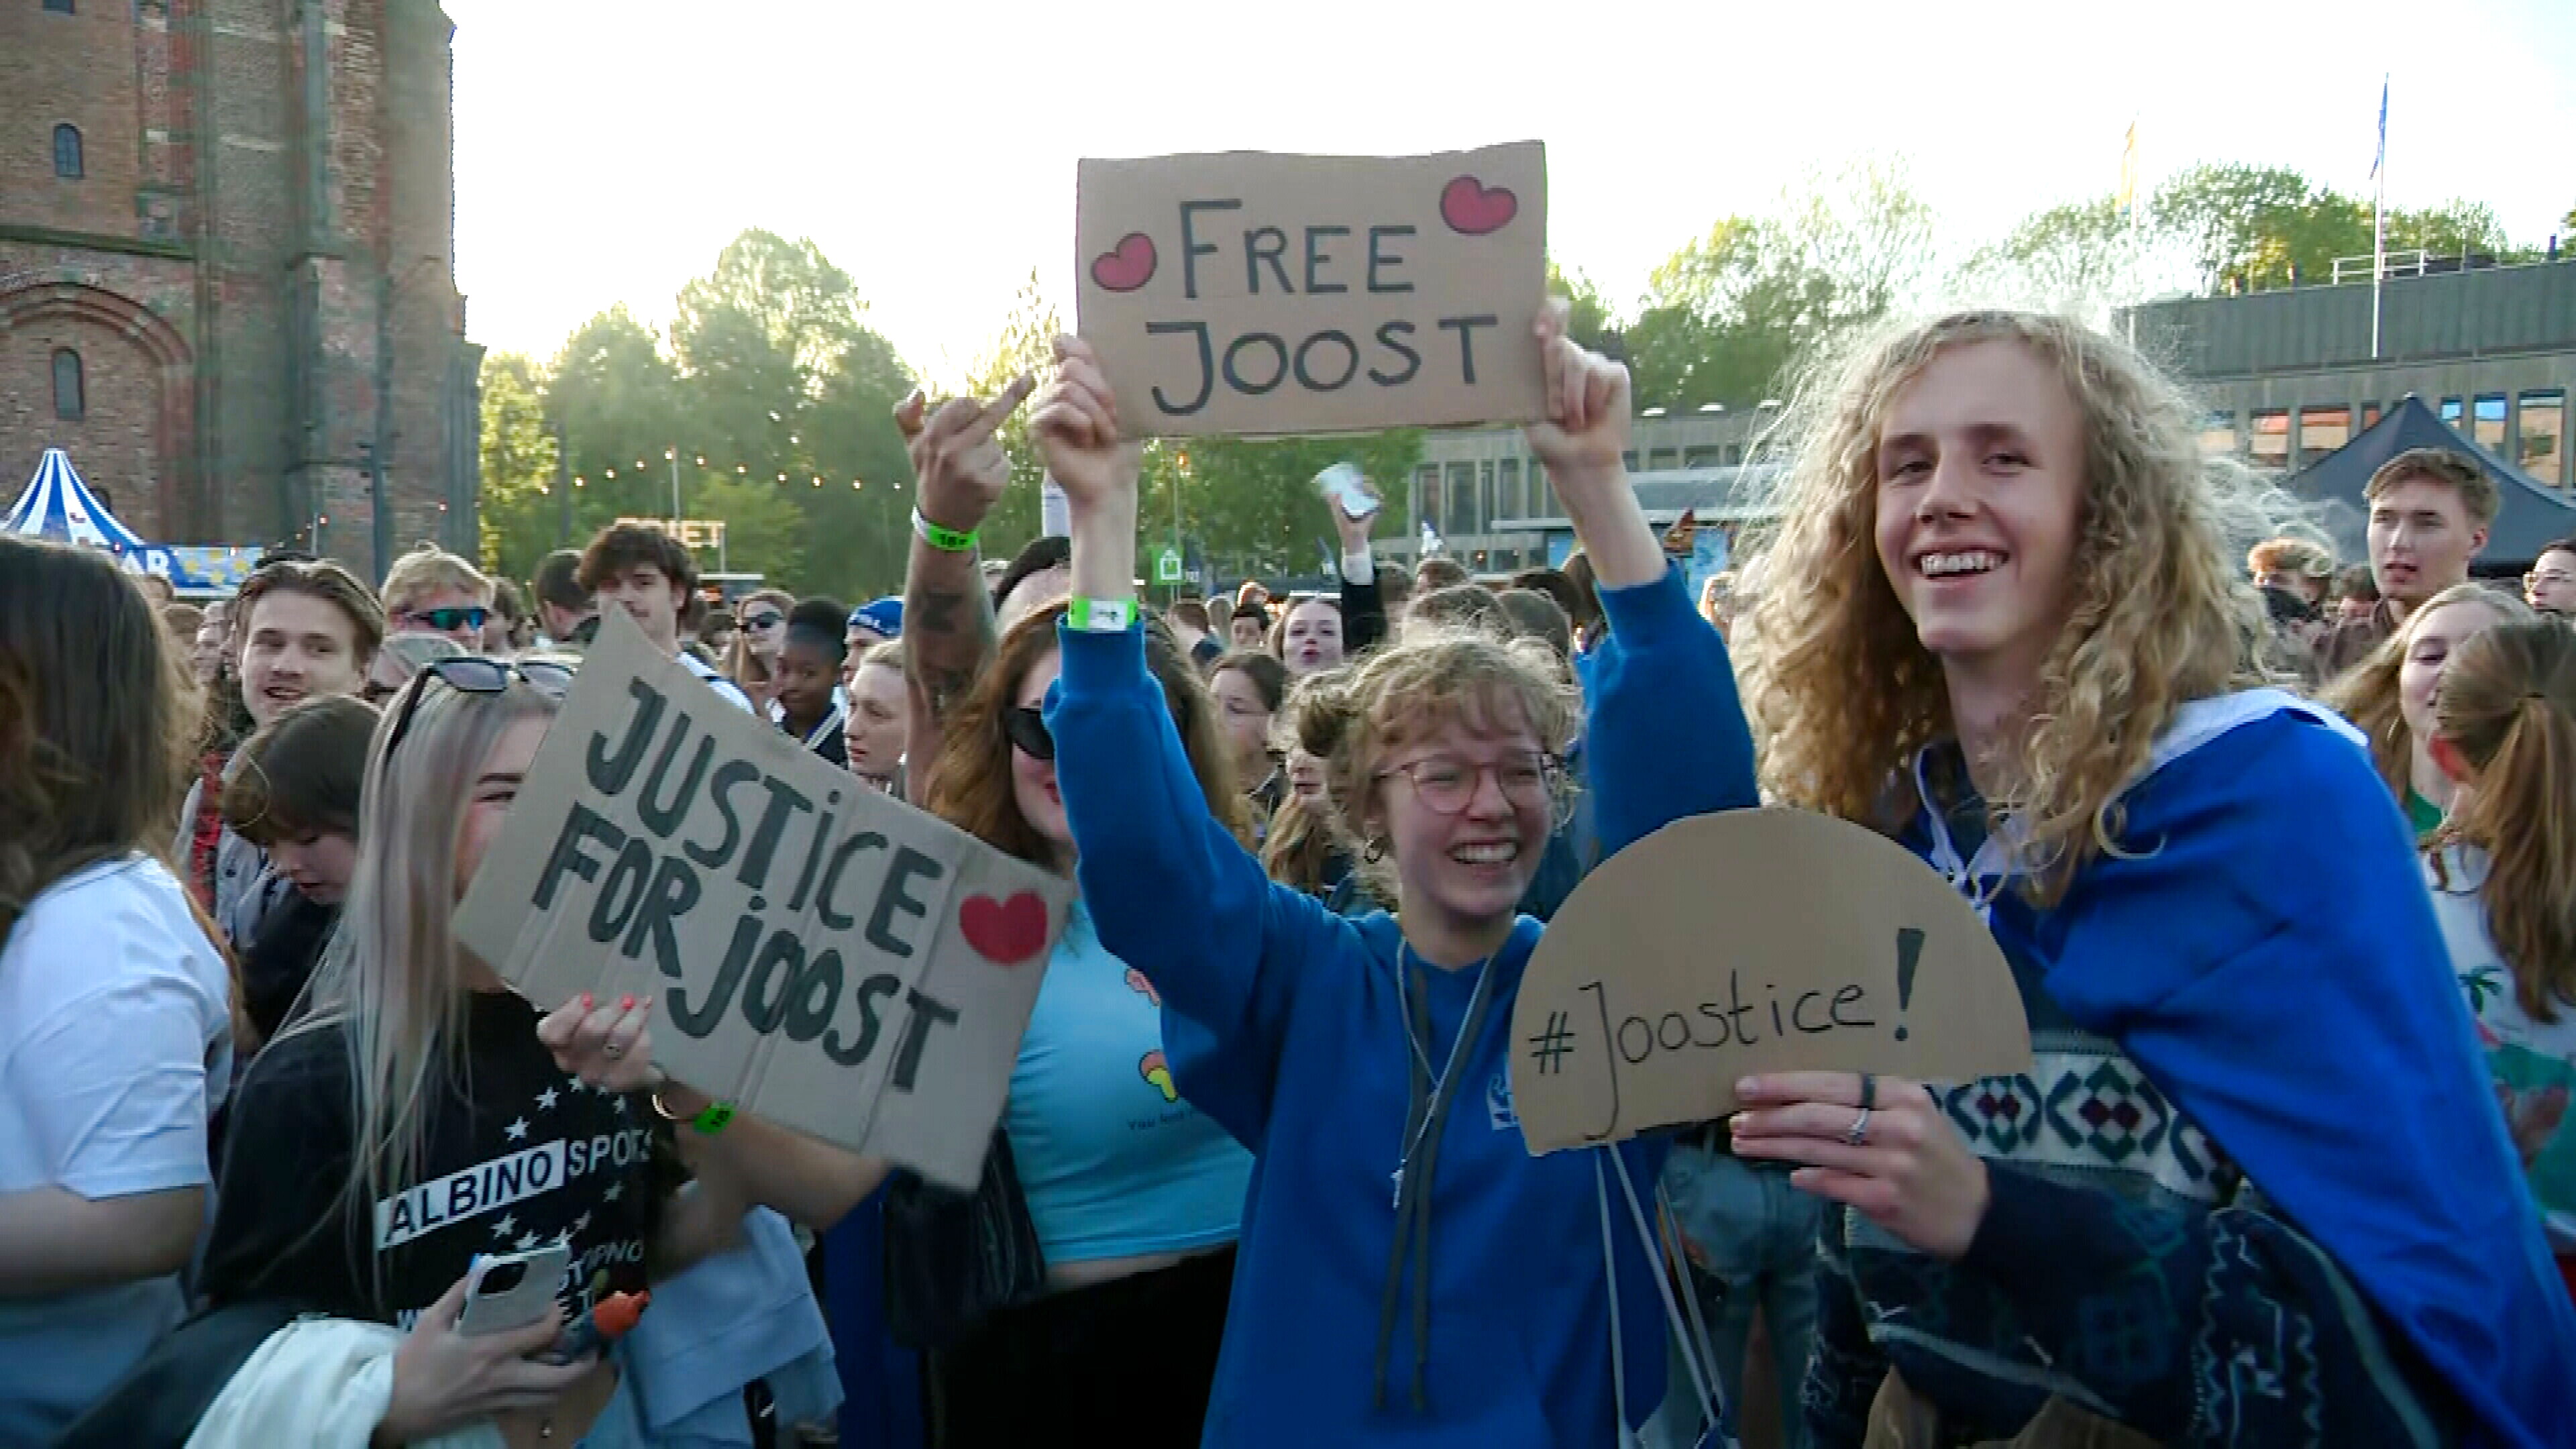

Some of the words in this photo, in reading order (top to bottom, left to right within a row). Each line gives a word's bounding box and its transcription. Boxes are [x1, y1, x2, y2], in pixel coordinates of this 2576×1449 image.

[1179, 198, 1417, 299] FREE
[1145, 313, 1498, 417] JOOST
[121, 548, 171, 576] AR
[531, 802, 702, 979] FOR
[385, 1150, 553, 1243] ALBINO
